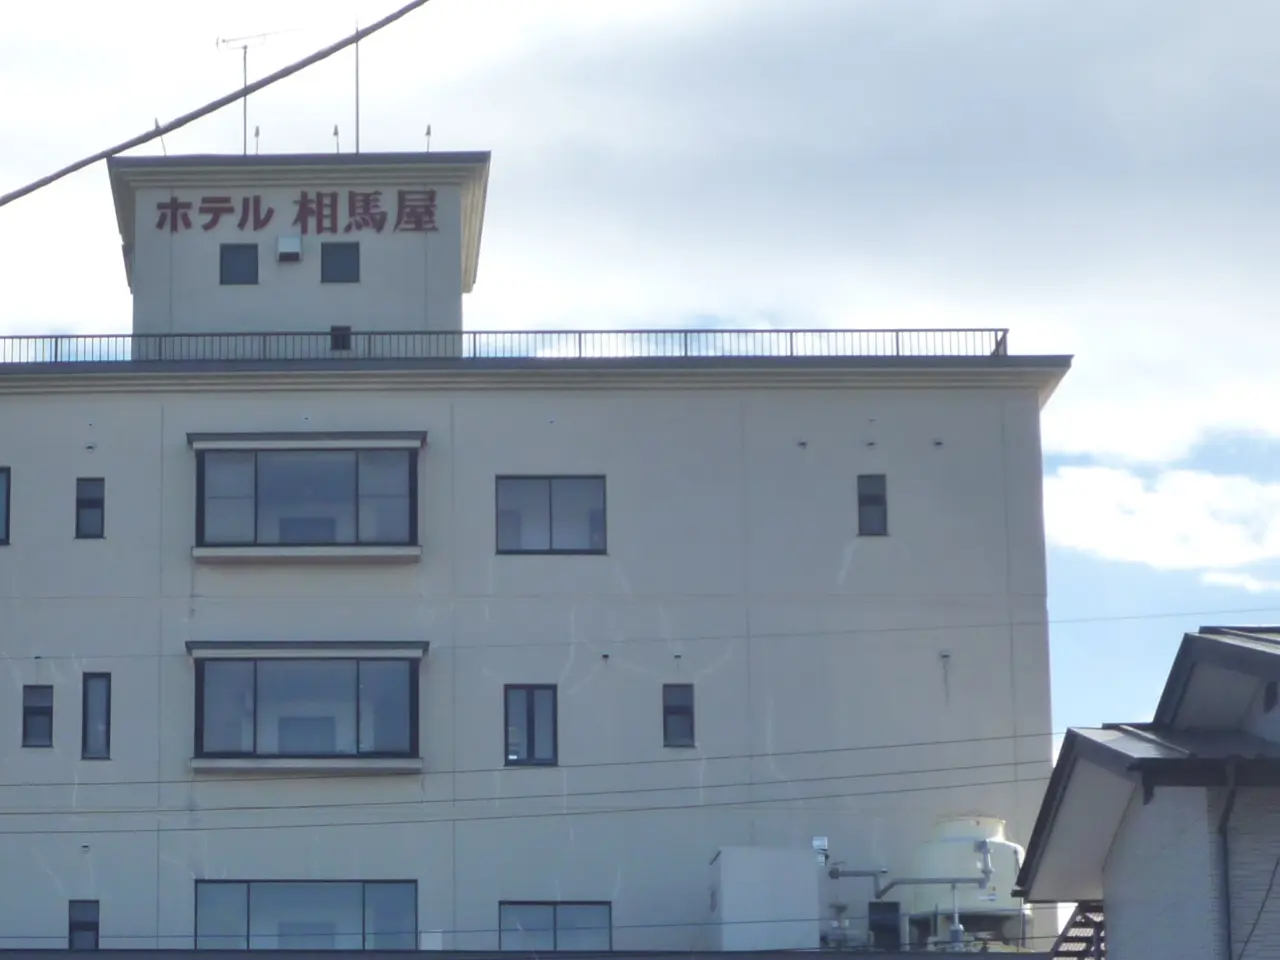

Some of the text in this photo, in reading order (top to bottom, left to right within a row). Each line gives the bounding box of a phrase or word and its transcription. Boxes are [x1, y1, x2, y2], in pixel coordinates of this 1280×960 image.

[155, 189, 439, 235] ホテル 相馬屋
